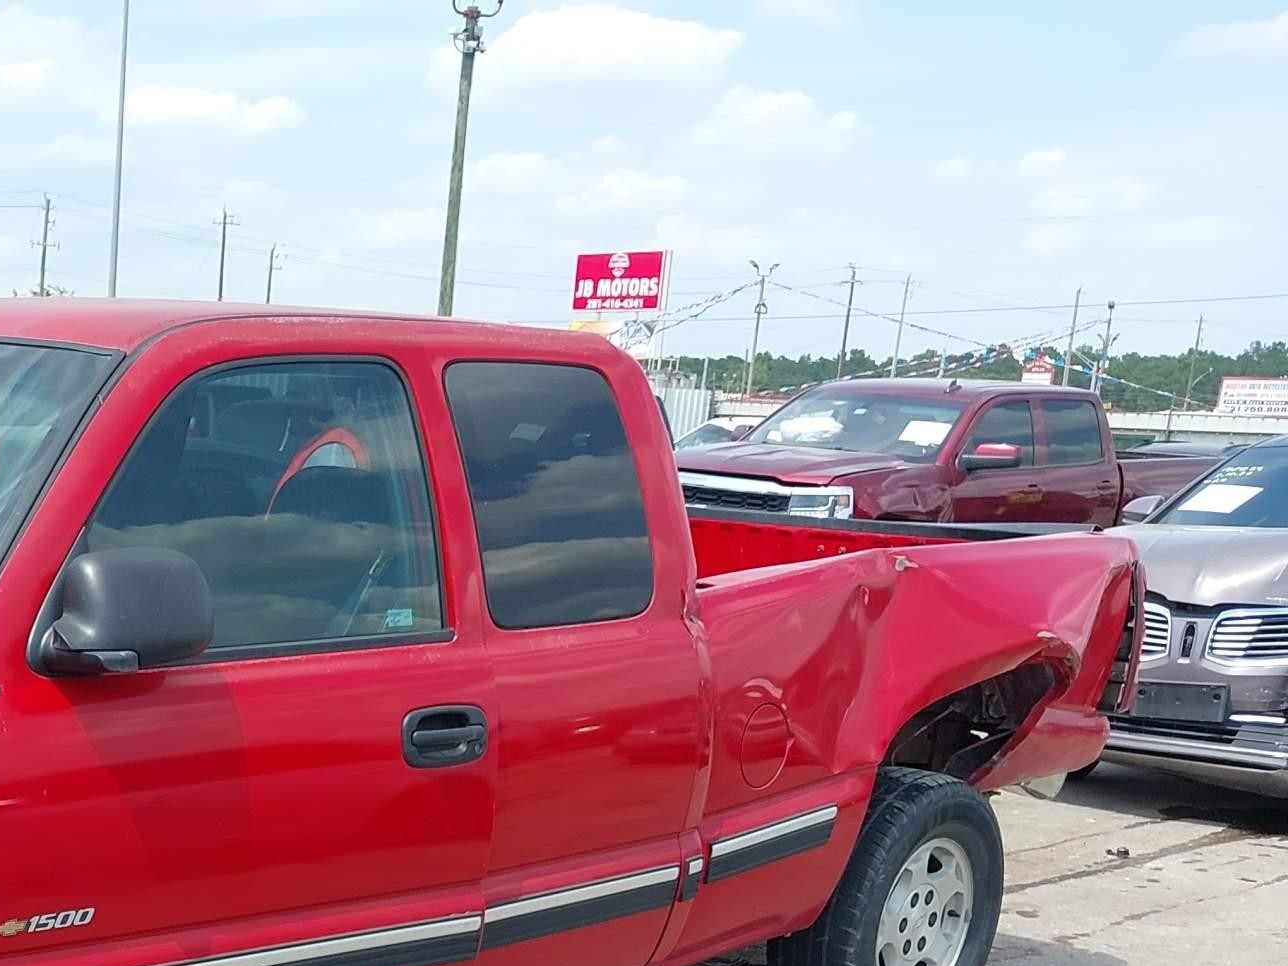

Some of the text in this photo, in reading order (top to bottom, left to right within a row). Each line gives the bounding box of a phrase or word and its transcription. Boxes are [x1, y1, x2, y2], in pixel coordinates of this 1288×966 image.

[576, 278, 659, 298] JB MOTORS
[27, 907, 96, 933] 1500
